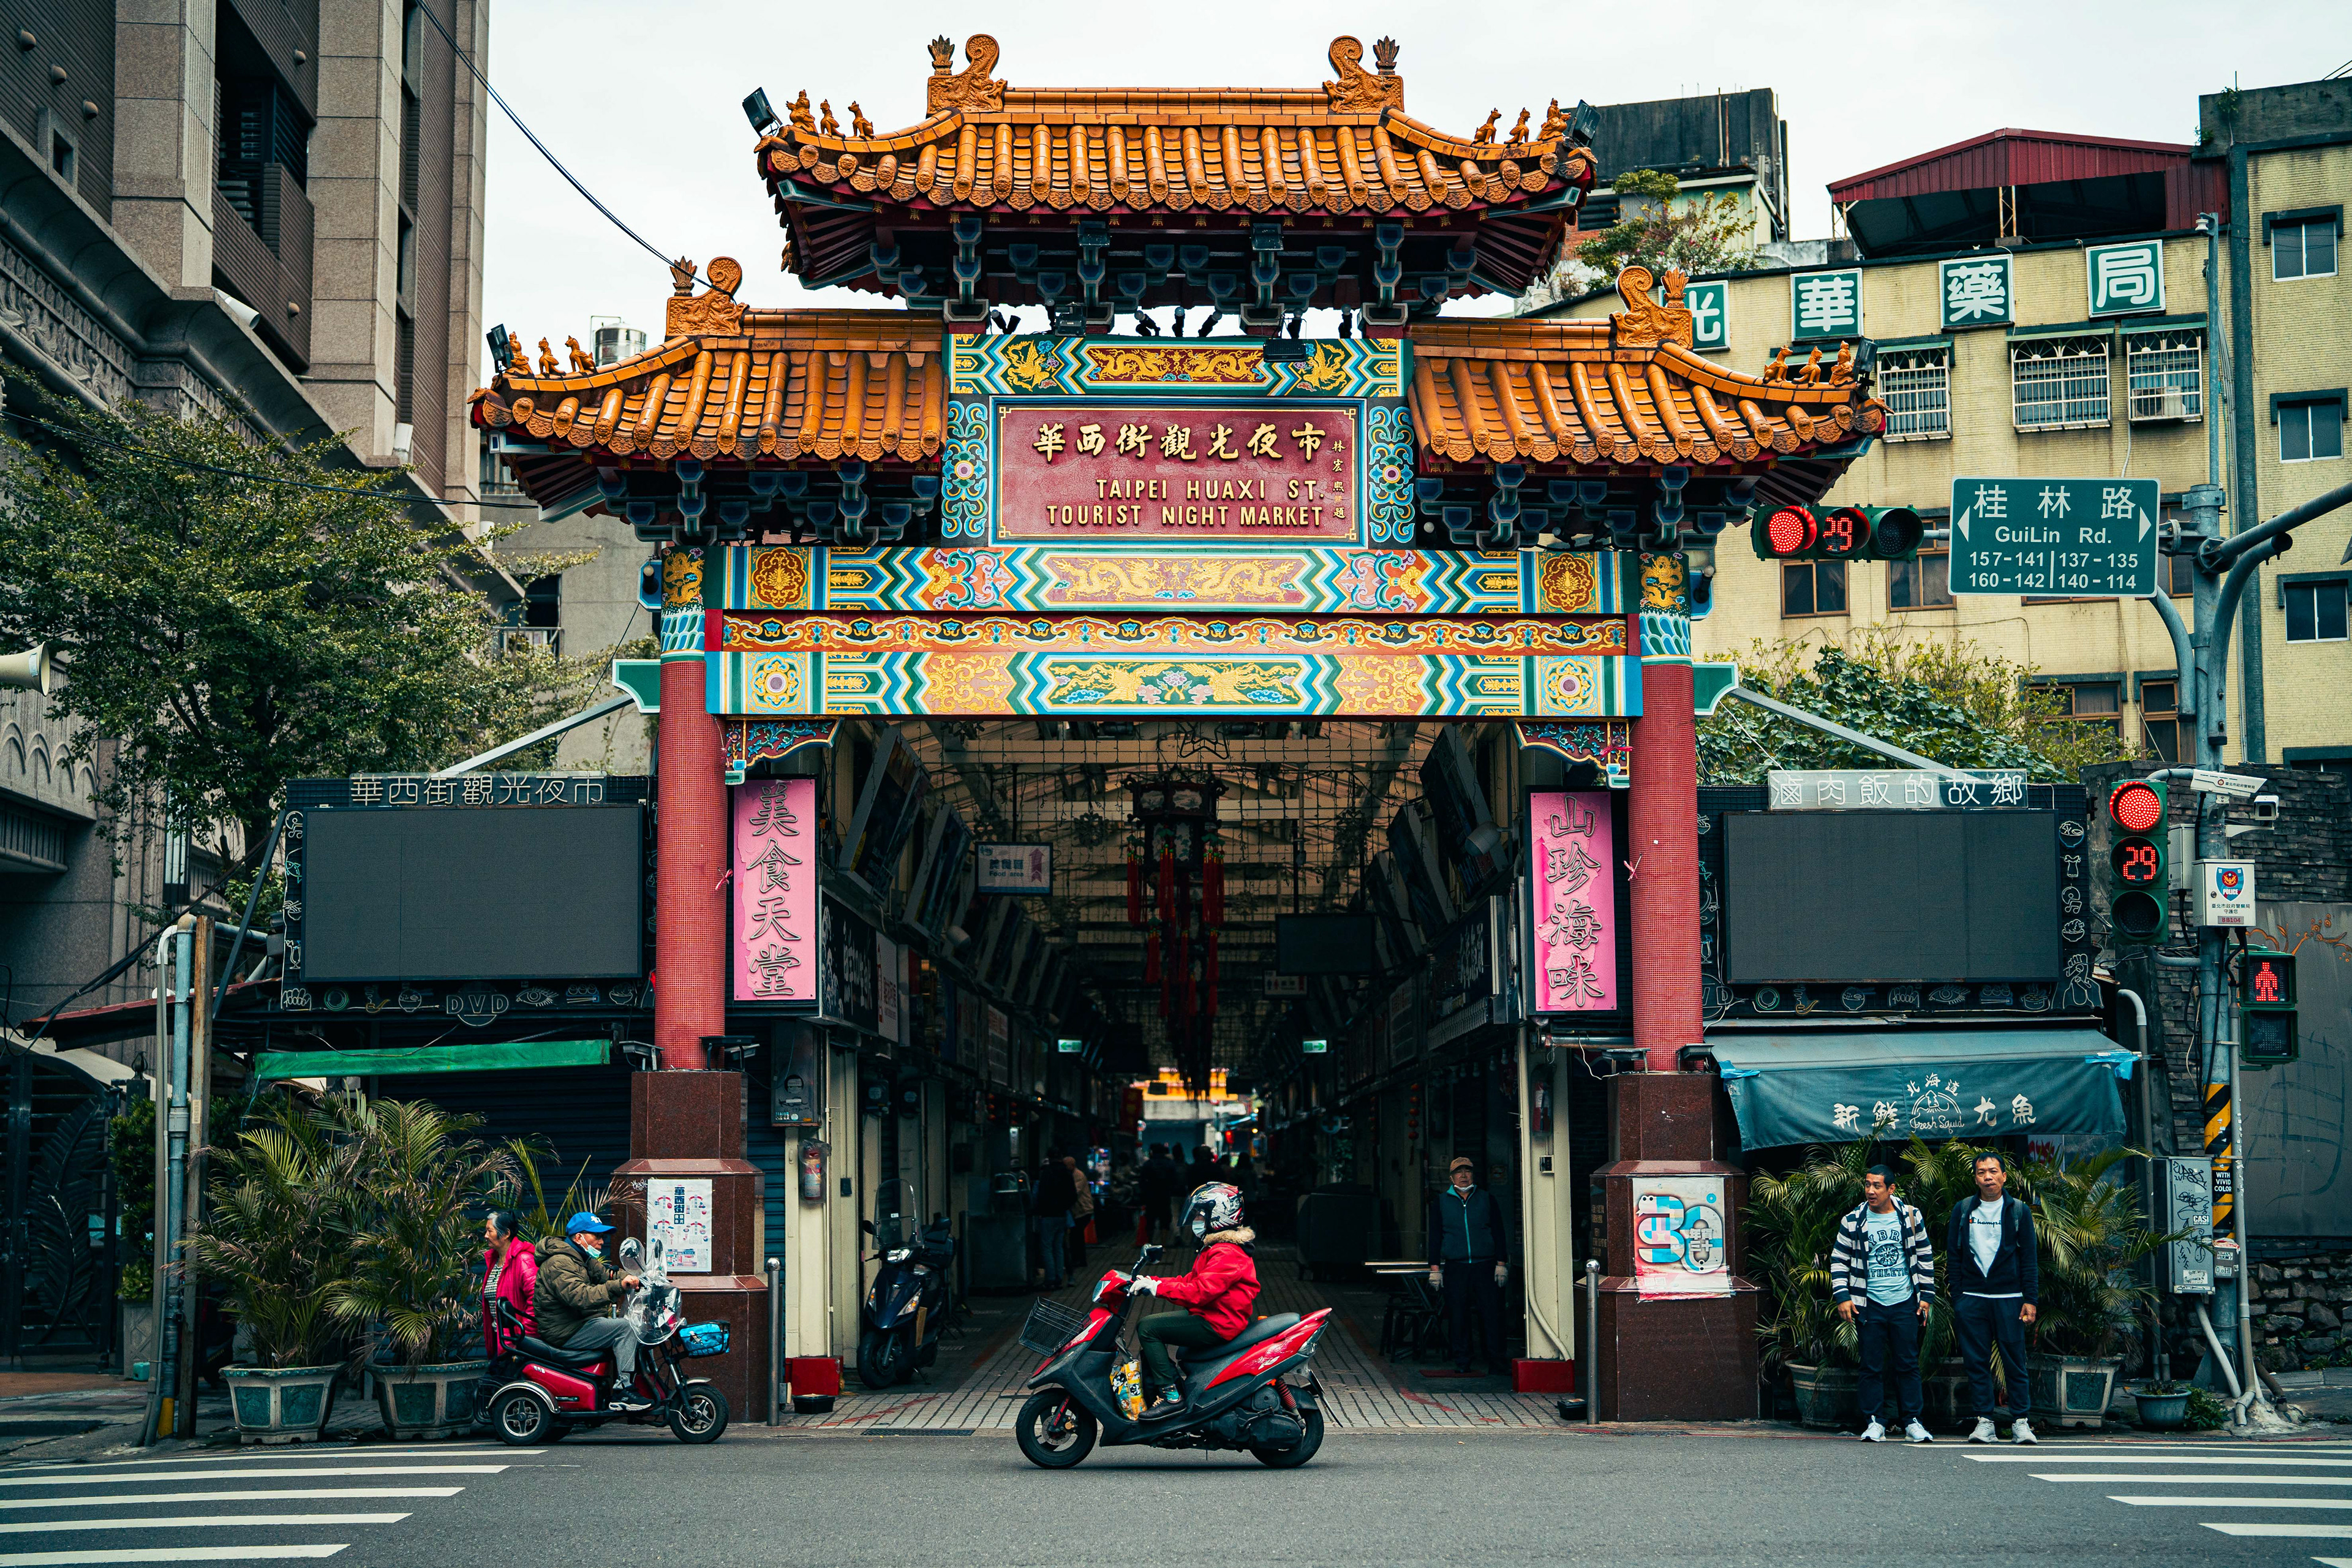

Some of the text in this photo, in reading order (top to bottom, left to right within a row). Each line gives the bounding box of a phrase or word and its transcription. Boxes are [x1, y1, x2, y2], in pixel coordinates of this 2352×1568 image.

[1033, 422, 1327, 461] 華西街觀光夜市
[1096, 479, 1325, 500] TAIPEI HUAXI ST.
[1973, 484, 2136, 519] 桂林路
[1047, 505, 1322, 526] TOURIST NIGHT MARKET
[1995, 526, 2111, 544] GuiLin Rd.
[1970, 552, 2044, 566] 157-141
[1969, 573, 2045, 587] 160-142
[350, 773, 604, 805] 華西街觀光夜市
[1771, 772, 2022, 805] 滷肉飯的故鄉
[2123, 846, 2156, 880] 29
[747, 783, 802, 996] 美食天堂
[1547, 796, 1605, 1006] 山珍海味
[447, 993, 509, 1014] DVD
[1907, 1072, 1960, 1096] 北海道
[1973, 1093, 2037, 1127] 尤魚
[1910, 1112, 1964, 1134] Fresh Squid
[1868, 1229, 1902, 1246] YBR
